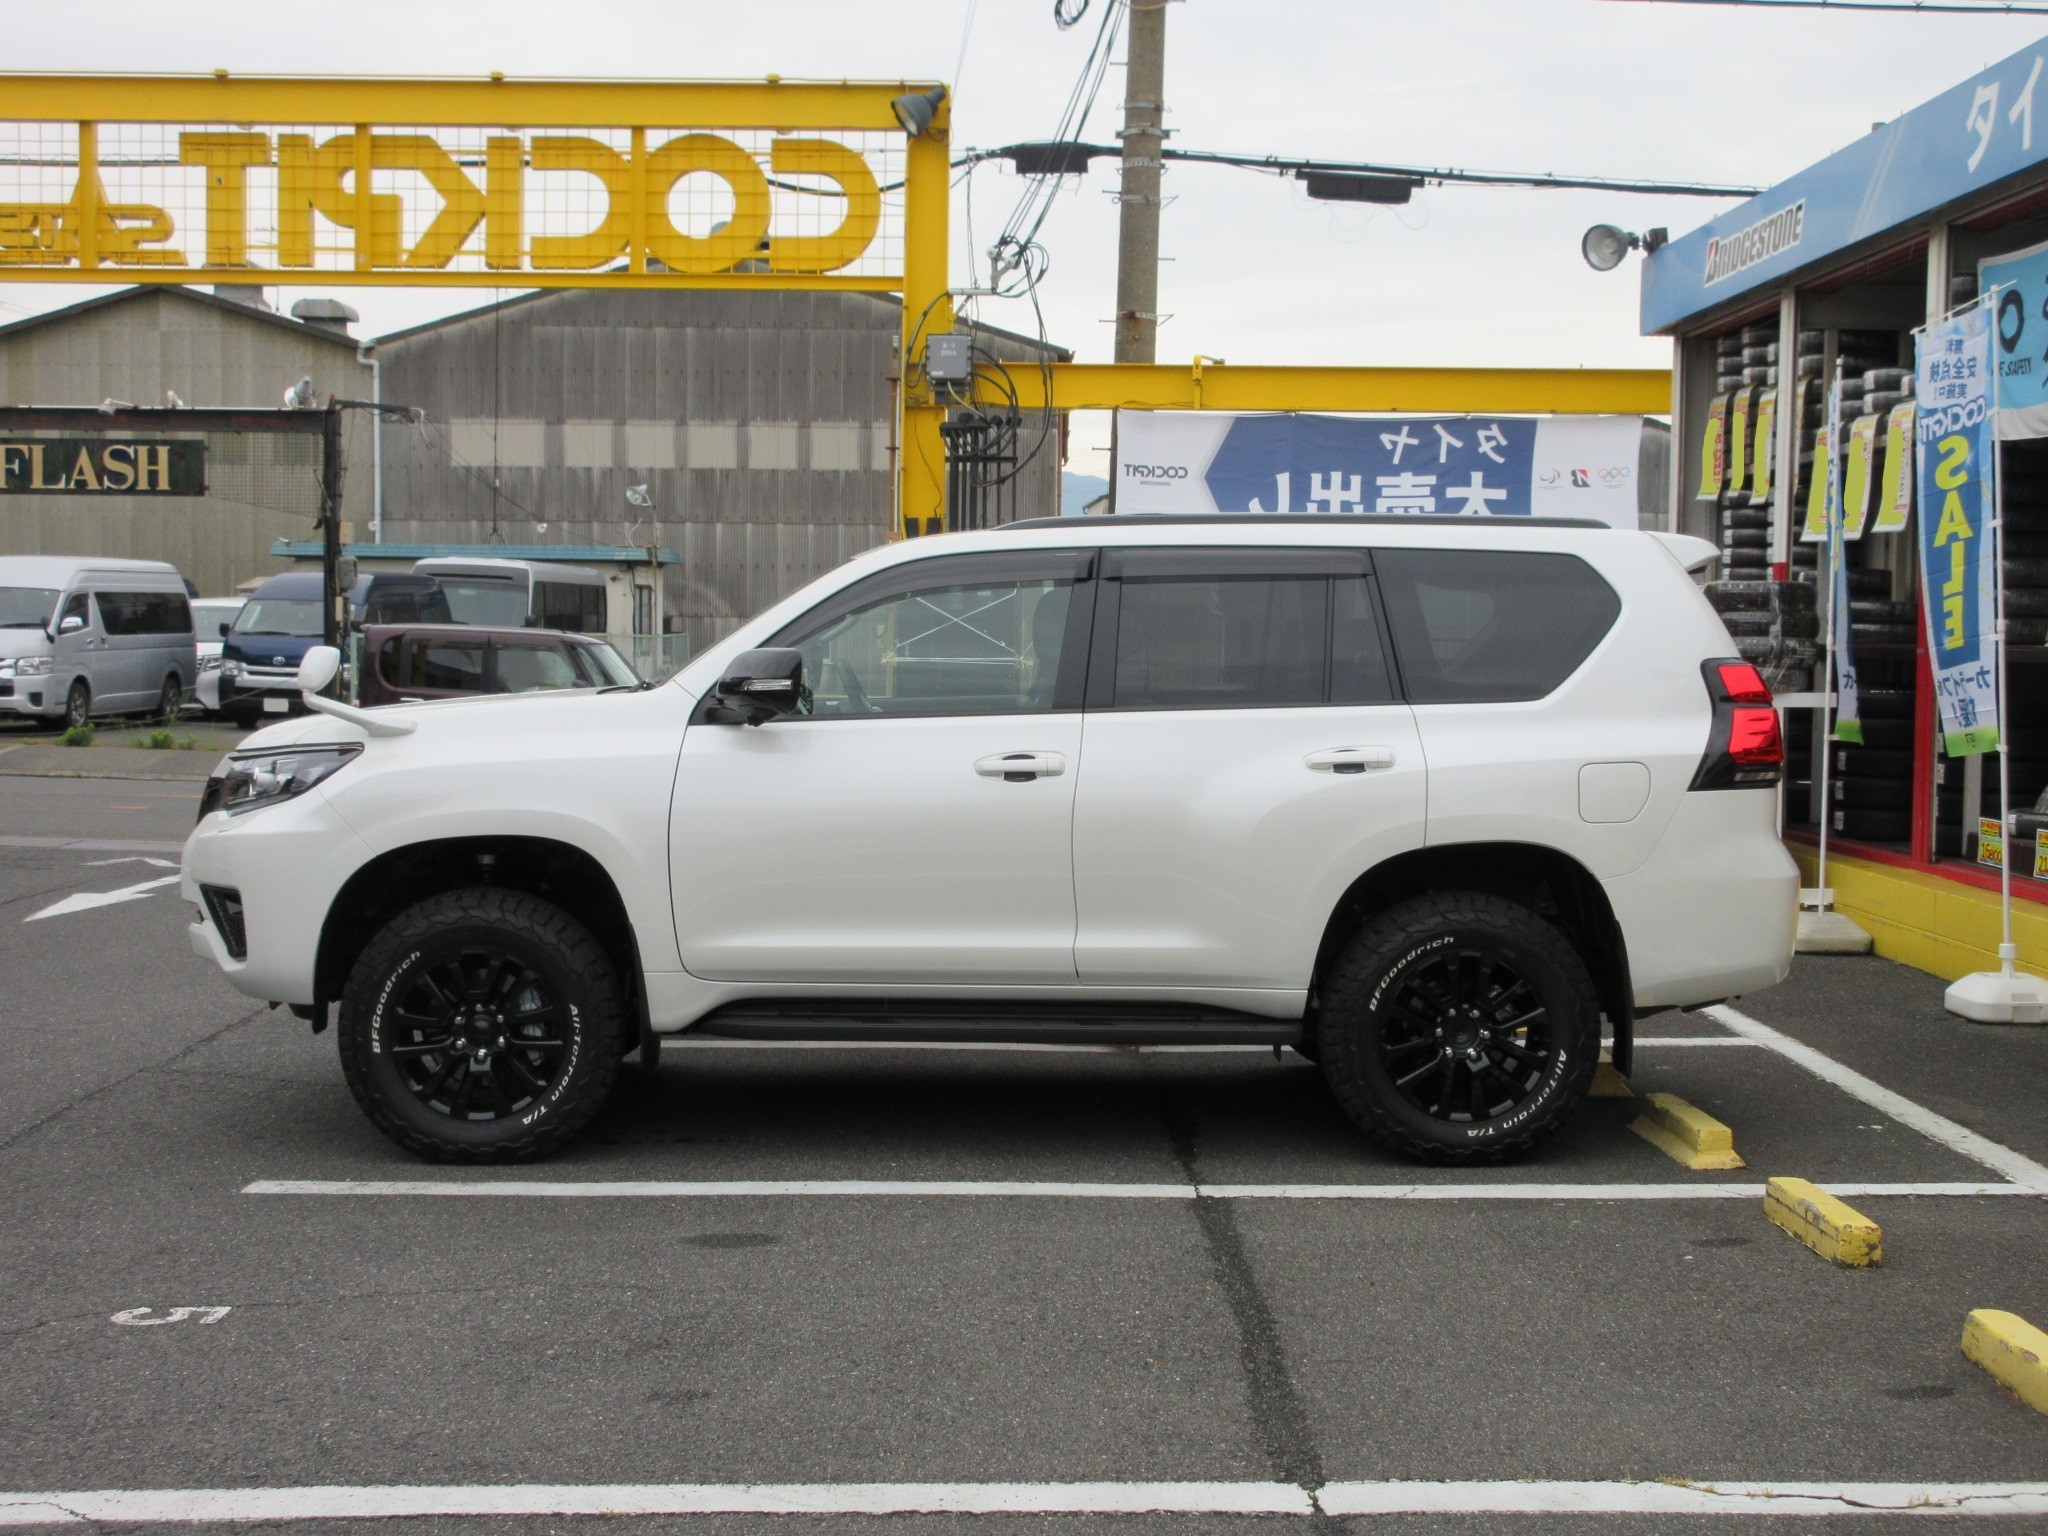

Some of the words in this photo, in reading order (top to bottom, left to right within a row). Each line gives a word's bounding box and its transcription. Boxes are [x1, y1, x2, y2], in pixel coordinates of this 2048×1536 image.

[1704, 199, 1805, 287] BRIDGESTONE
[2005, 357, 2032, 377] SAFETY
[0, 444, 172, 491] FLASH
[371, 951, 421, 1054] BFGoodrich
[1369, 936, 1455, 1012] BFGoodrich
[551, 1003, 581, 1101] All-Terrain
[1503, 1049, 1567, 1129] All-Terrain
[522, 1105, 548, 1125] T/A
[1467, 1126, 1496, 1137] T/A
